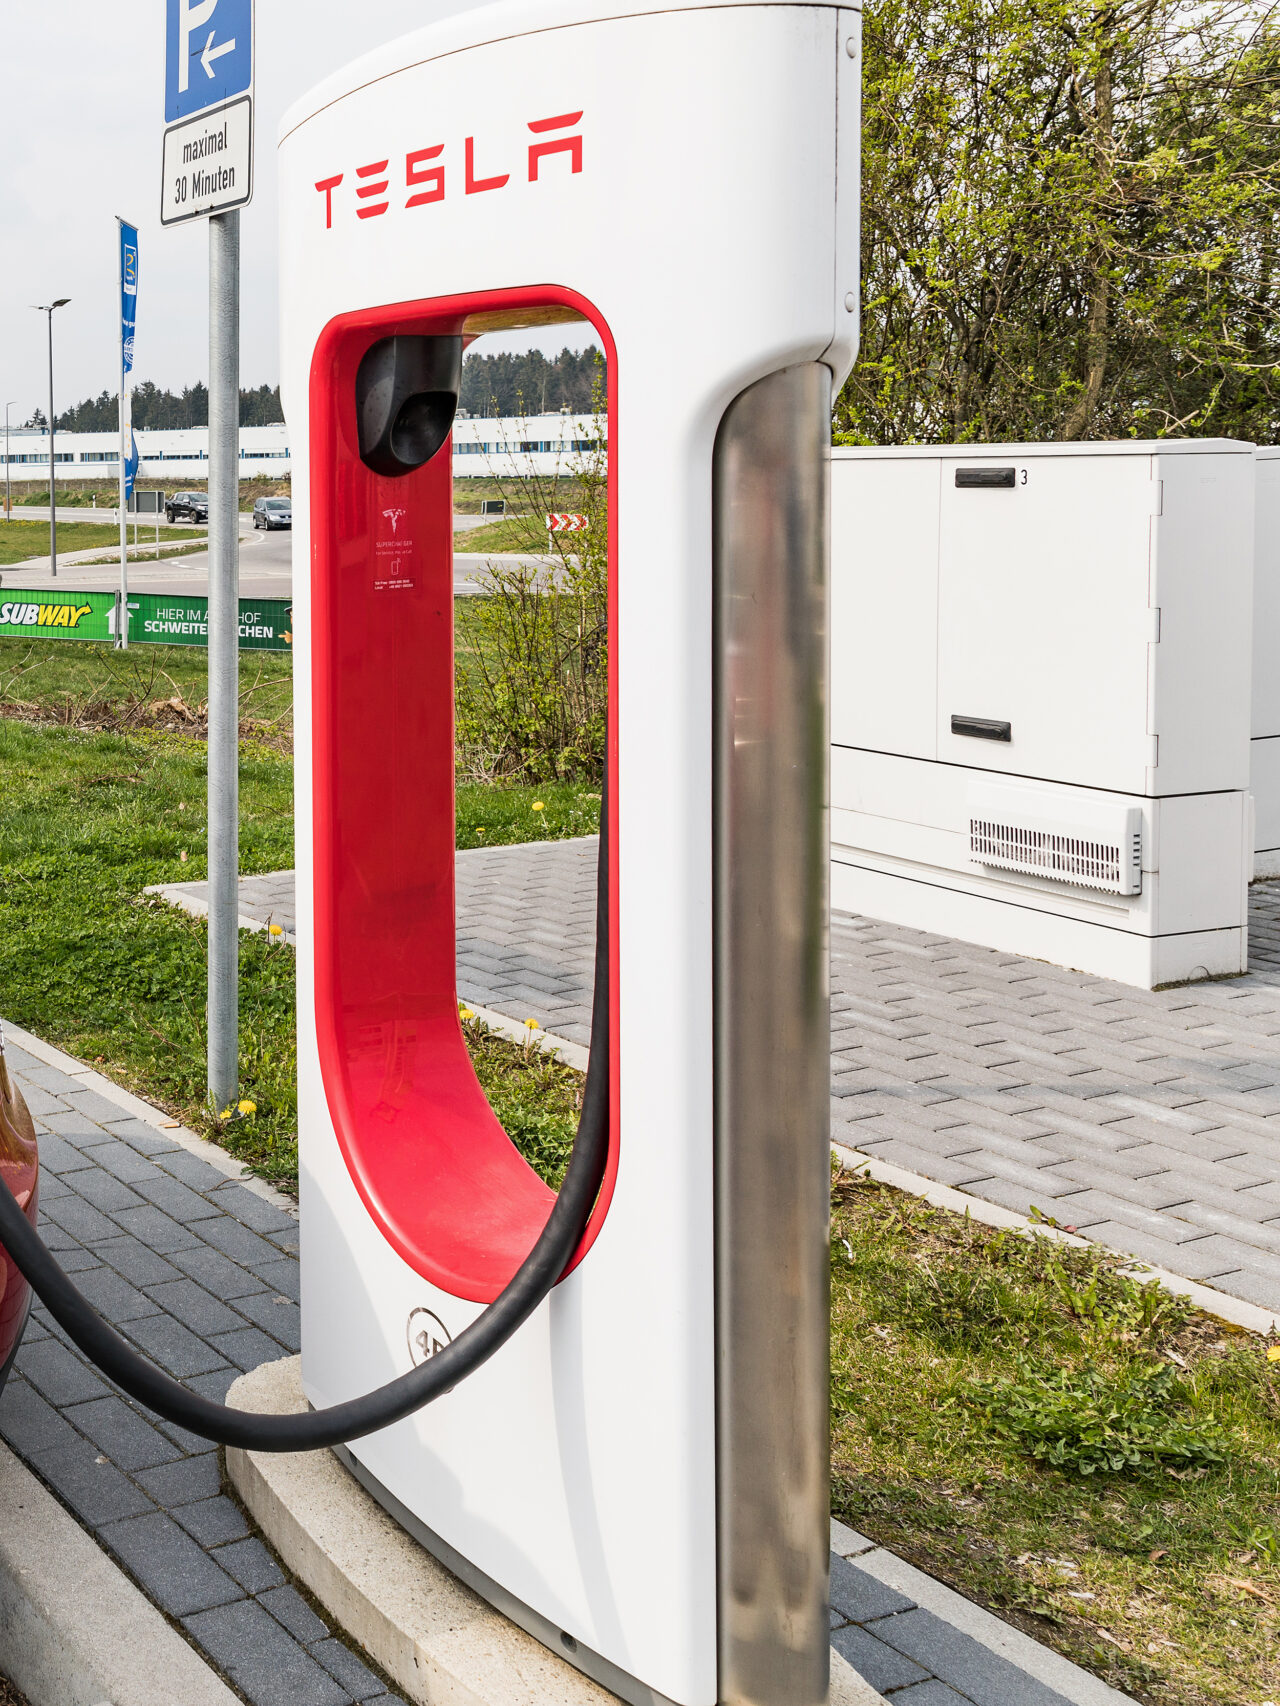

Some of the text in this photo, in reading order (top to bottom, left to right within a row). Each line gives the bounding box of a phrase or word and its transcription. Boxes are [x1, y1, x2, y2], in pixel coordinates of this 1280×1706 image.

[178, 0, 218, 94] P
[183, 121, 228, 164] maximal
[175, 165, 235, 205] 30 Minuten
[314, 110, 584, 229] TESLA
[1020, 469, 1028, 486] 3
[144, 620, 273, 639] SCHWEITECHEN
[156, 608, 262, 624] HIER IM AHOF
